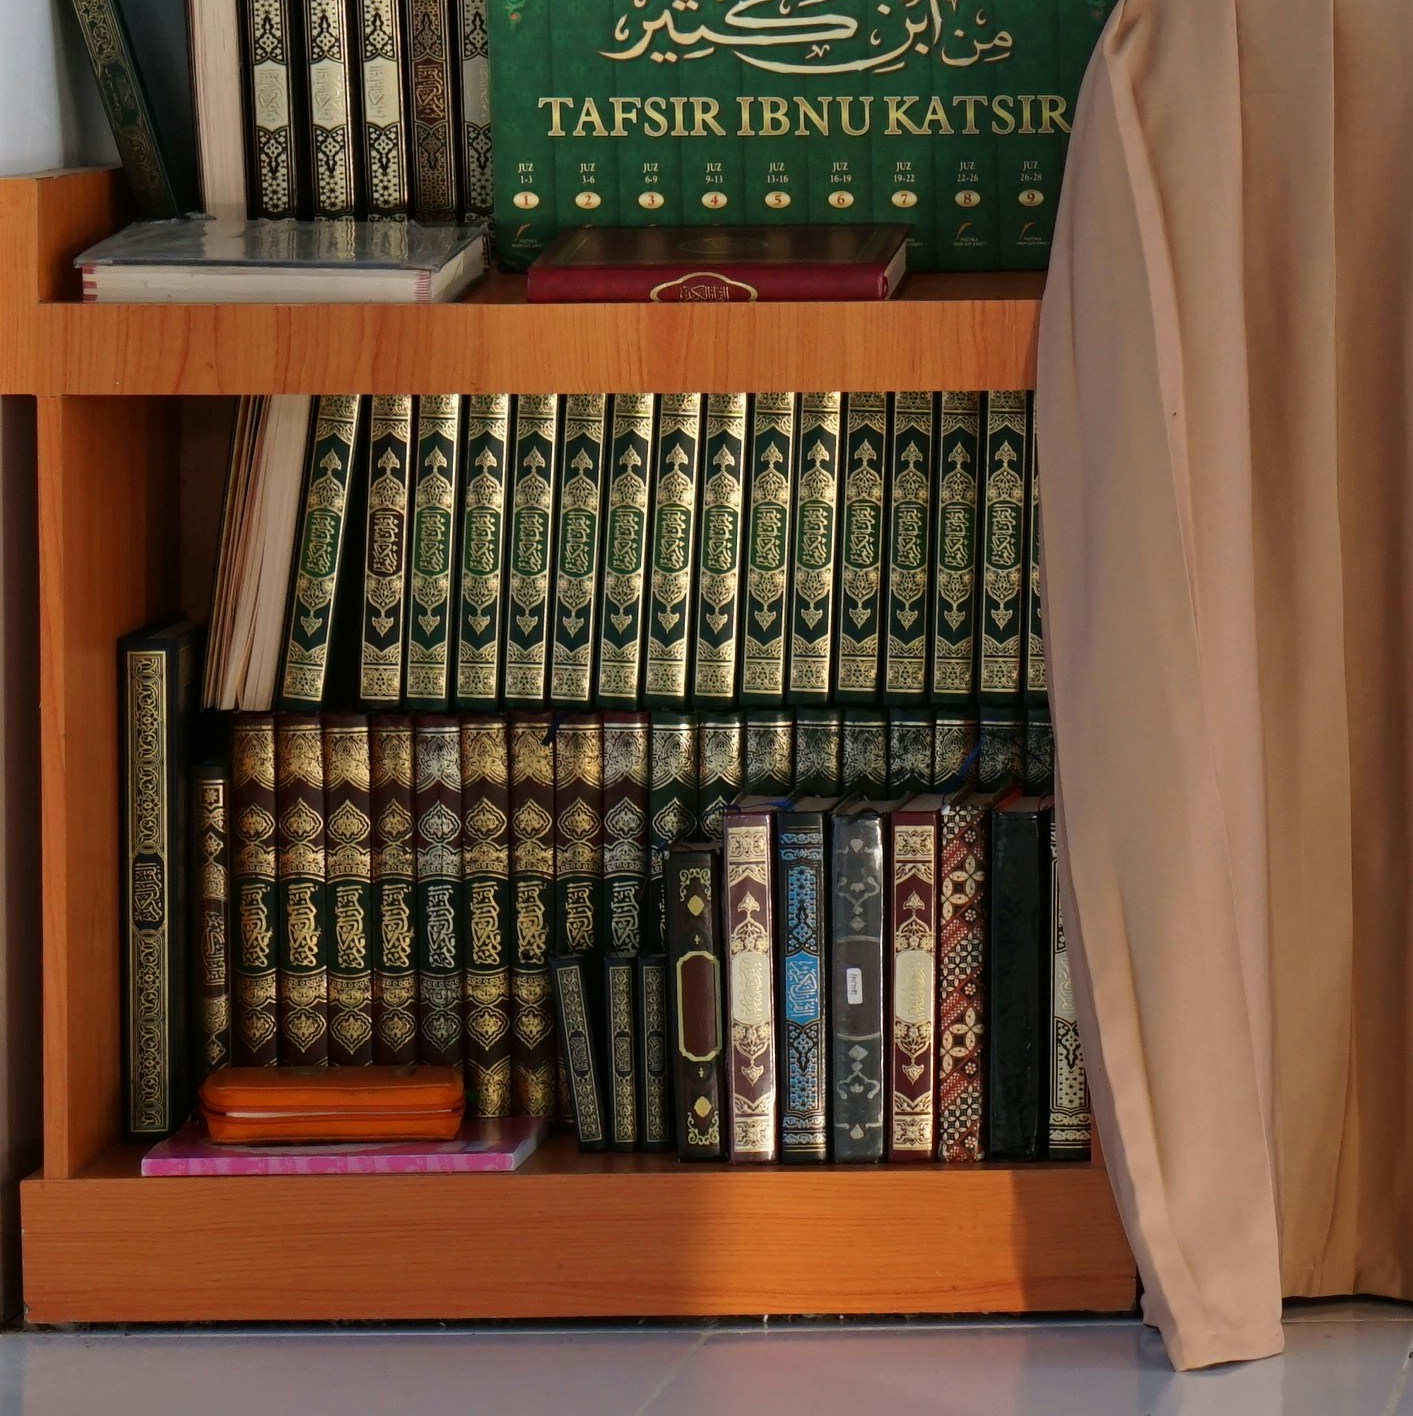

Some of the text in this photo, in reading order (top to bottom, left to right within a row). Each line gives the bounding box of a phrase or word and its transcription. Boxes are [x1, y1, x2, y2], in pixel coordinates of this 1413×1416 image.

[538, 94, 1072, 137] TAFSIR IBNU KATSIR
[518, 163, 534, 173] JUZ
[580, 163, 595, 173] JUZ
[643, 163, 659, 173] JUZ
[706, 162, 722, 172] JUZ
[769, 162, 784, 172] JUZ
[832, 162, 848, 172] JUZ
[896, 162, 911, 171] JUZ
[959, 161, 975, 171] JUZ
[1023, 161, 1038, 170] JUZ
[520, 175, 533, 184] 1-3
[582, 175, 595, 184] 3-6
[644, 175, 658, 184] 6-9
[705, 175, 723, 184] 9-13
[767, 175, 789, 184] 13-16
[830, 174, 852, 183] 16-19
[894, 174, 915, 183] 19-22
[957, 174, 979, 183] 22-26
[1020, 173, 1042, 182] 26-28
[523, 195, 530, 206] 1
[585, 195, 592, 206] 2
[647, 195, 655, 206] 3
[710, 195, 719, 206] 4
[774, 195, 782, 206] 5
[837, 194, 846, 205] 6
[900, 194, 908, 204] 7
[963, 193, 972, 204] 8
[1026, 193, 1035, 203] 9
